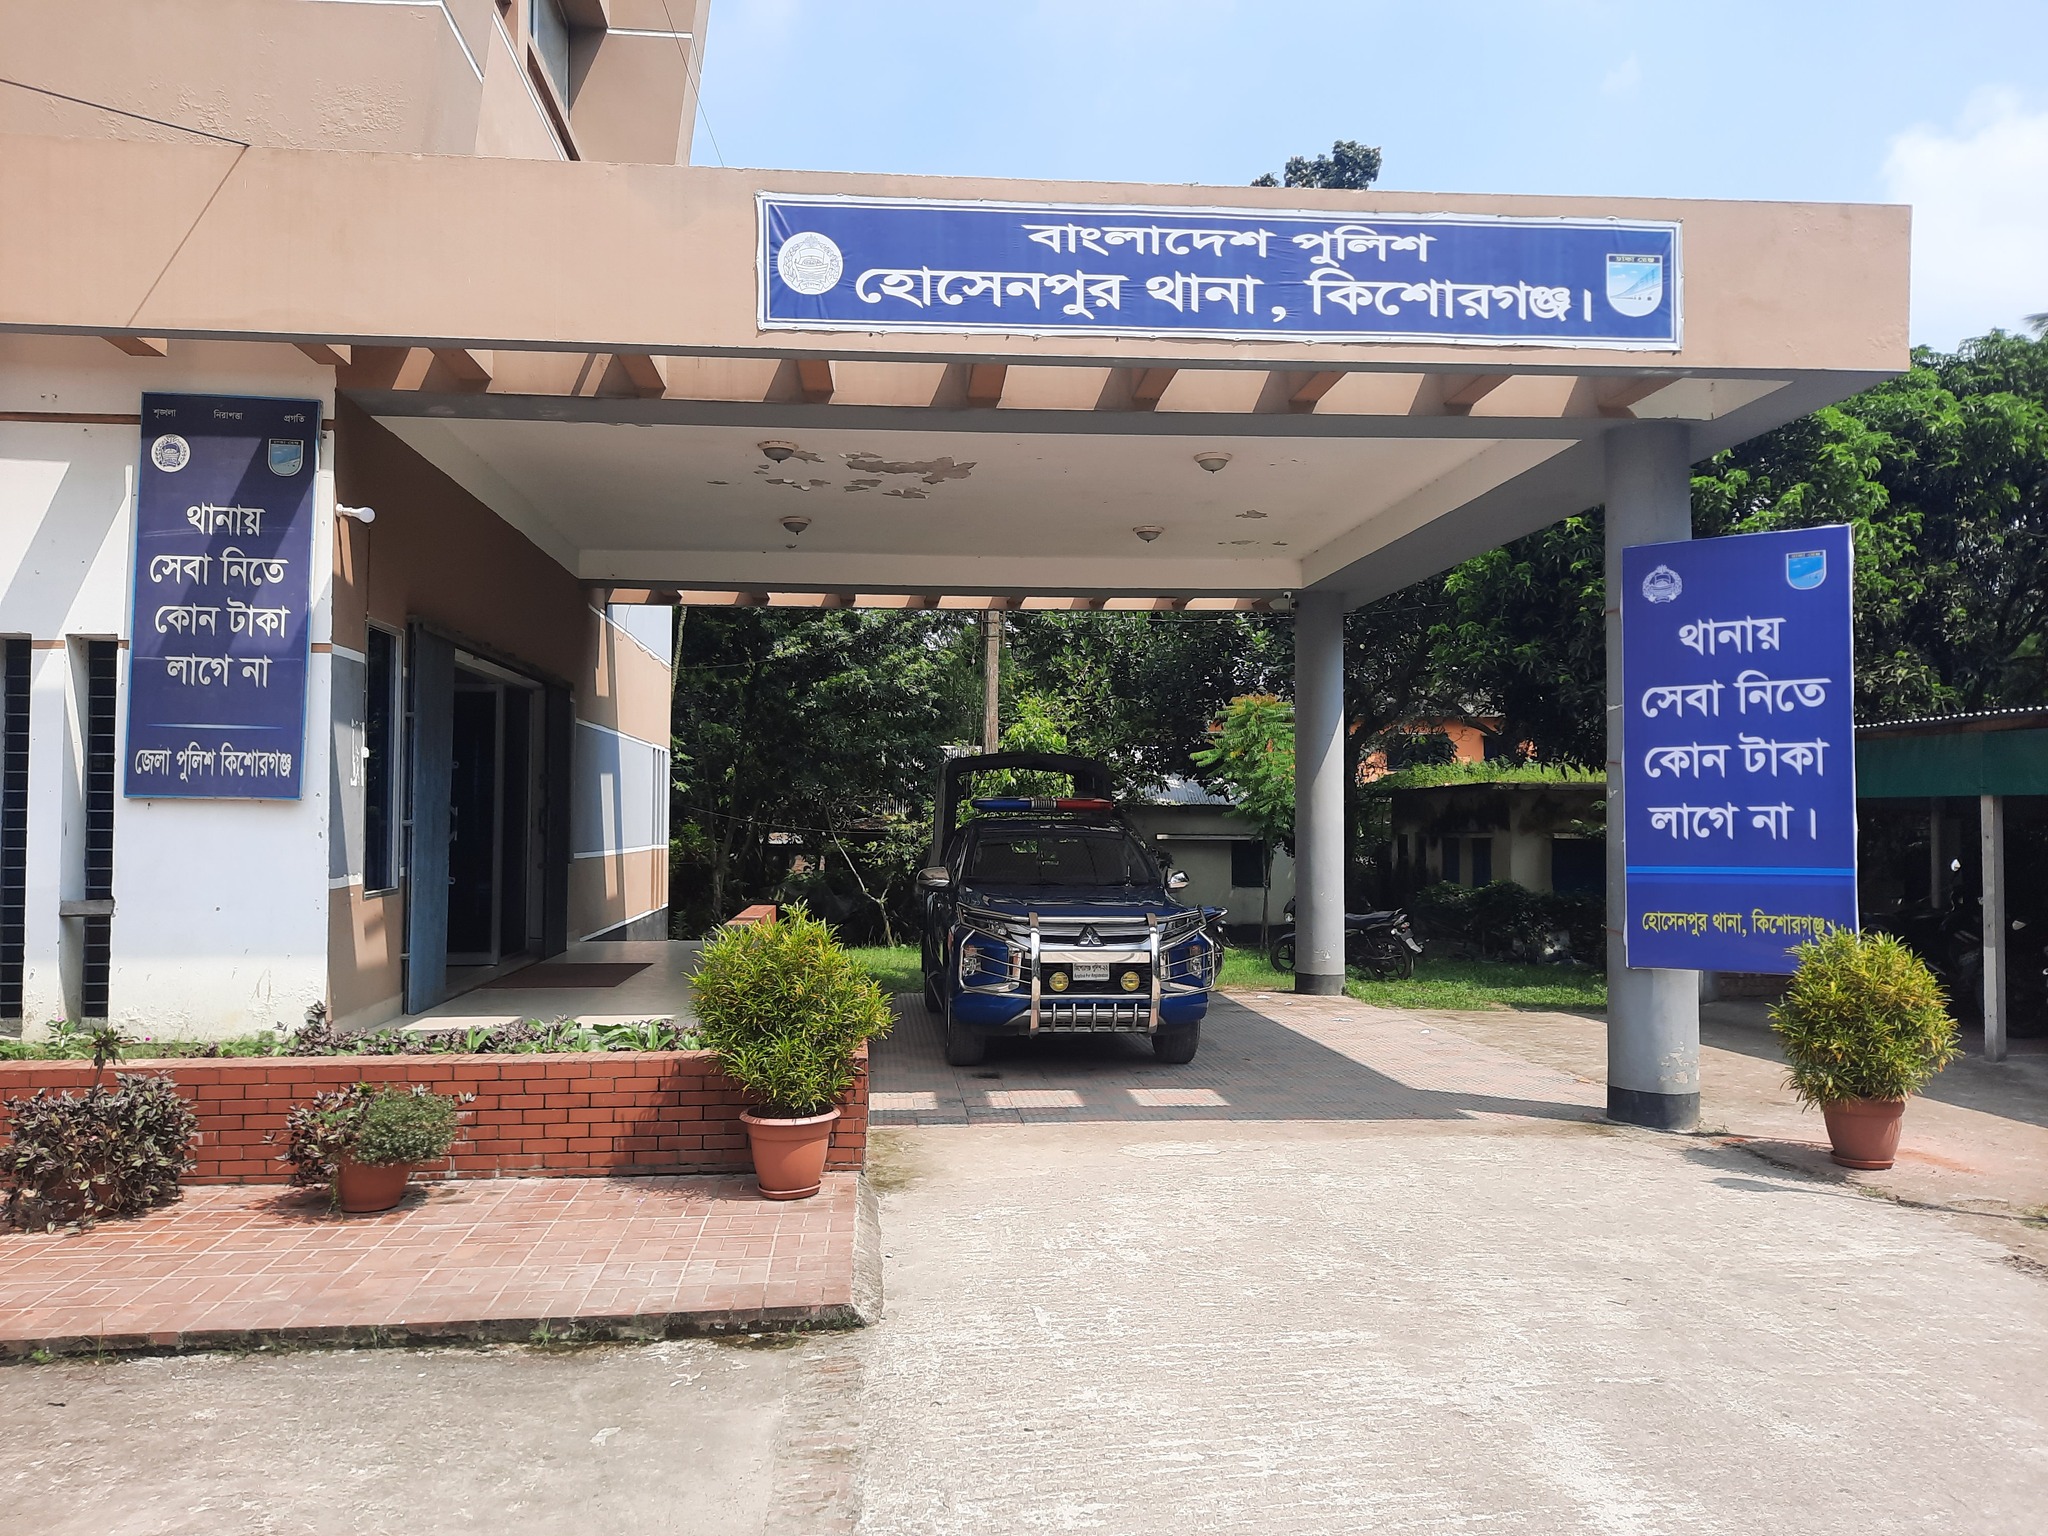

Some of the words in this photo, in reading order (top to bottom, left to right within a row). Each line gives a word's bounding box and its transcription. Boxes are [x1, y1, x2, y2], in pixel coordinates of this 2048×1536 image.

[1021, 222, 1276, 258] বাংলাদেশ
[1292, 225, 1438, 267] পুলিশ
[855, 266, 1130, 320] হোসেনপুর
[186, 502, 266, 537] থানায়
[149, 552, 213, 586] সেবা
[219, 546, 289, 587] নিতে
[154, 602, 221, 637] কোন
[226, 596, 291, 639] টাকা
[1678, 615, 1787, 656] থানায়
[164, 653, 234, 688] লাগে
[239, 654, 273, 689] না
[1641, 679, 1726, 719] সেবা
[1733, 669, 1832, 715] নিতে
[134, 744, 172, 777] জেলা
[176, 741, 216, 783] পুলিশ
[219, 741, 292, 779] কিশোরগঞ্জ
[1644, 741, 1732, 779] কোন
[1738, 732, 1830, 777] টাকা
[1647, 801, 1740, 840] লাগে
[1642, 911, 1709, 937] হোসেনপুর
